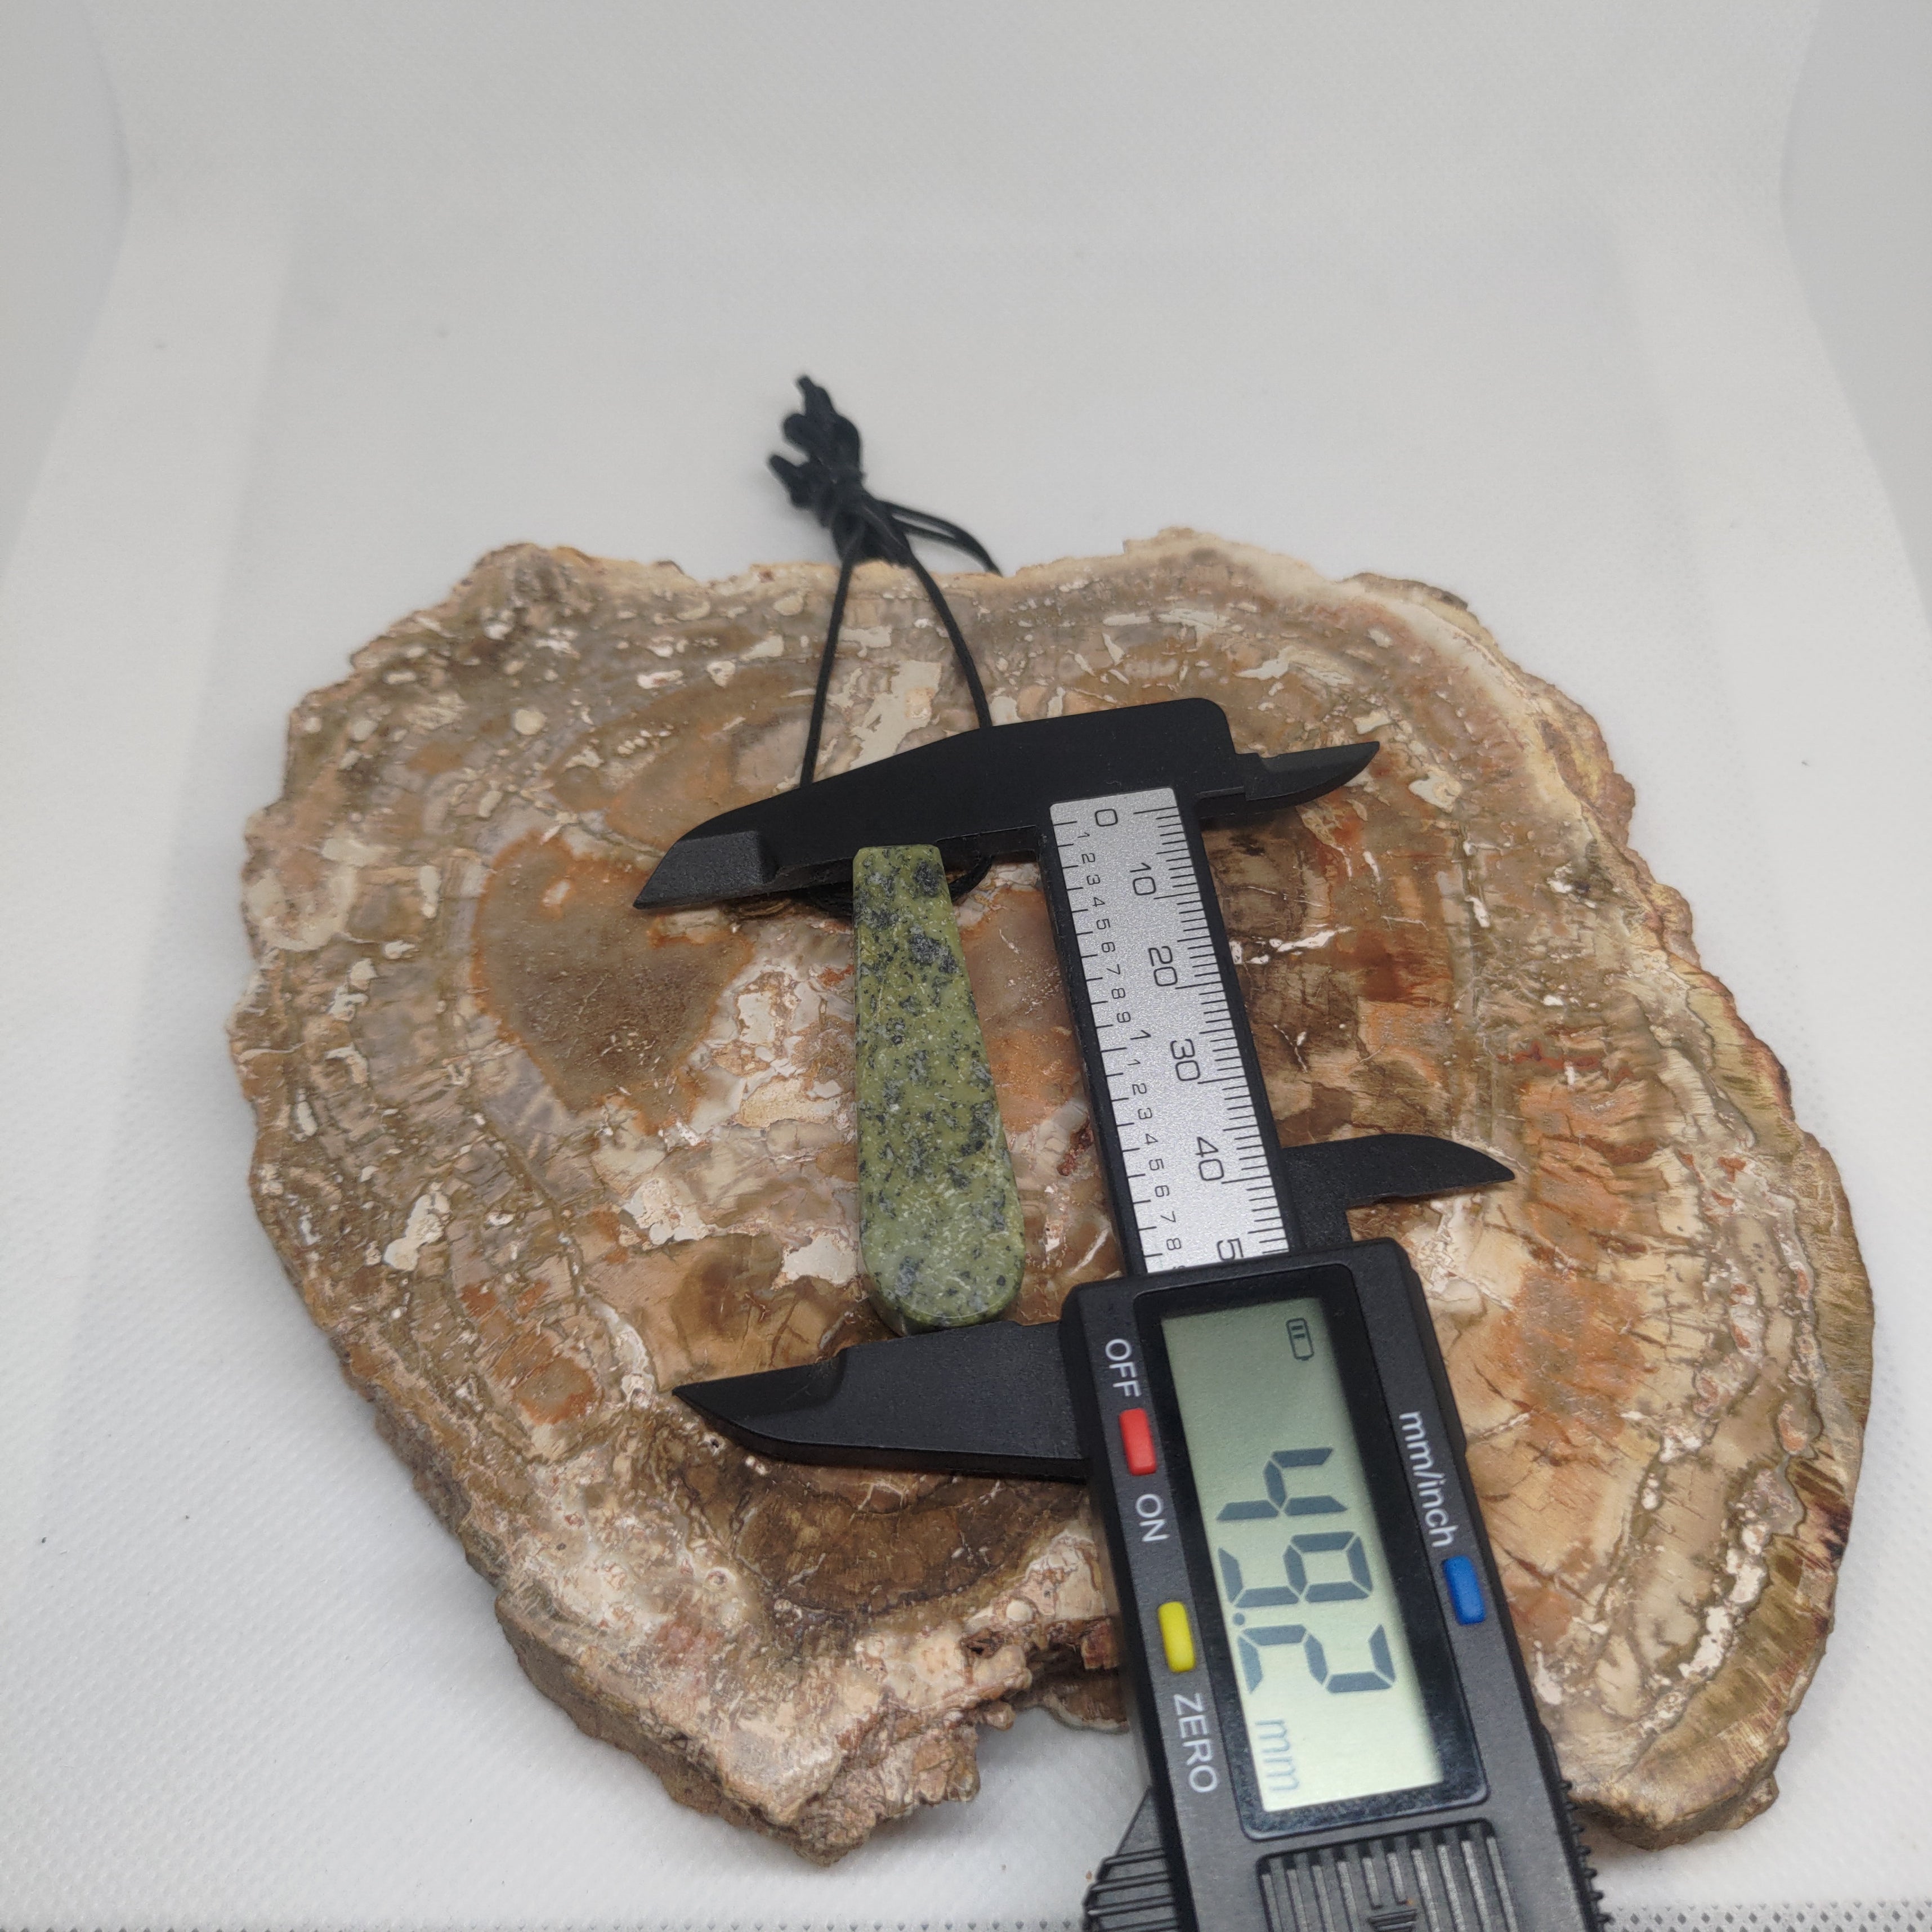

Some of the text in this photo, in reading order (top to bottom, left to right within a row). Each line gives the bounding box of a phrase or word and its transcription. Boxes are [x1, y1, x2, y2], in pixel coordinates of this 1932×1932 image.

[1081, 852, 1095, 864] 2
[1086, 874, 1101, 885] 3
[1092, 897, 1106, 907] 4
[1096, 918, 1111, 929] 5
[1101, 941, 1116, 952] 6
[1106, 964, 1121, 975] 7
[1094, 808, 1118, 827] 0
[1130, 862, 1157, 896] 10
[1148, 946, 1178, 987] 20
[1170, 1039, 1201, 1081] 30
[1195, 1137, 1224, 1181] 40
[1111, 987, 1126, 999] 8
[1116, 1012, 1131, 1023] 9
[1130, 1030, 1151, 1040] 1
[1132, 1083, 1147, 1095] 2
[1137, 1107, 1153, 1120] 3
[1144, 1134, 1159, 1145] 4
[1148, 1159, 1164, 1171] 5
[1155, 1185, 1170, 1197] 6
[1160, 1211, 1177, 1223] 7
[1166, 1238, 1182, 1251] 8
[1104, 1338, 1142, 1398] OFF
[1399, 1411, 1459, 1548] mm/inch
[1134, 1493, 1169, 1543] ON
[1217, 1447, 1397, 1793] 49.2 mm
[1173, 1692, 1218, 1794] ZERO
